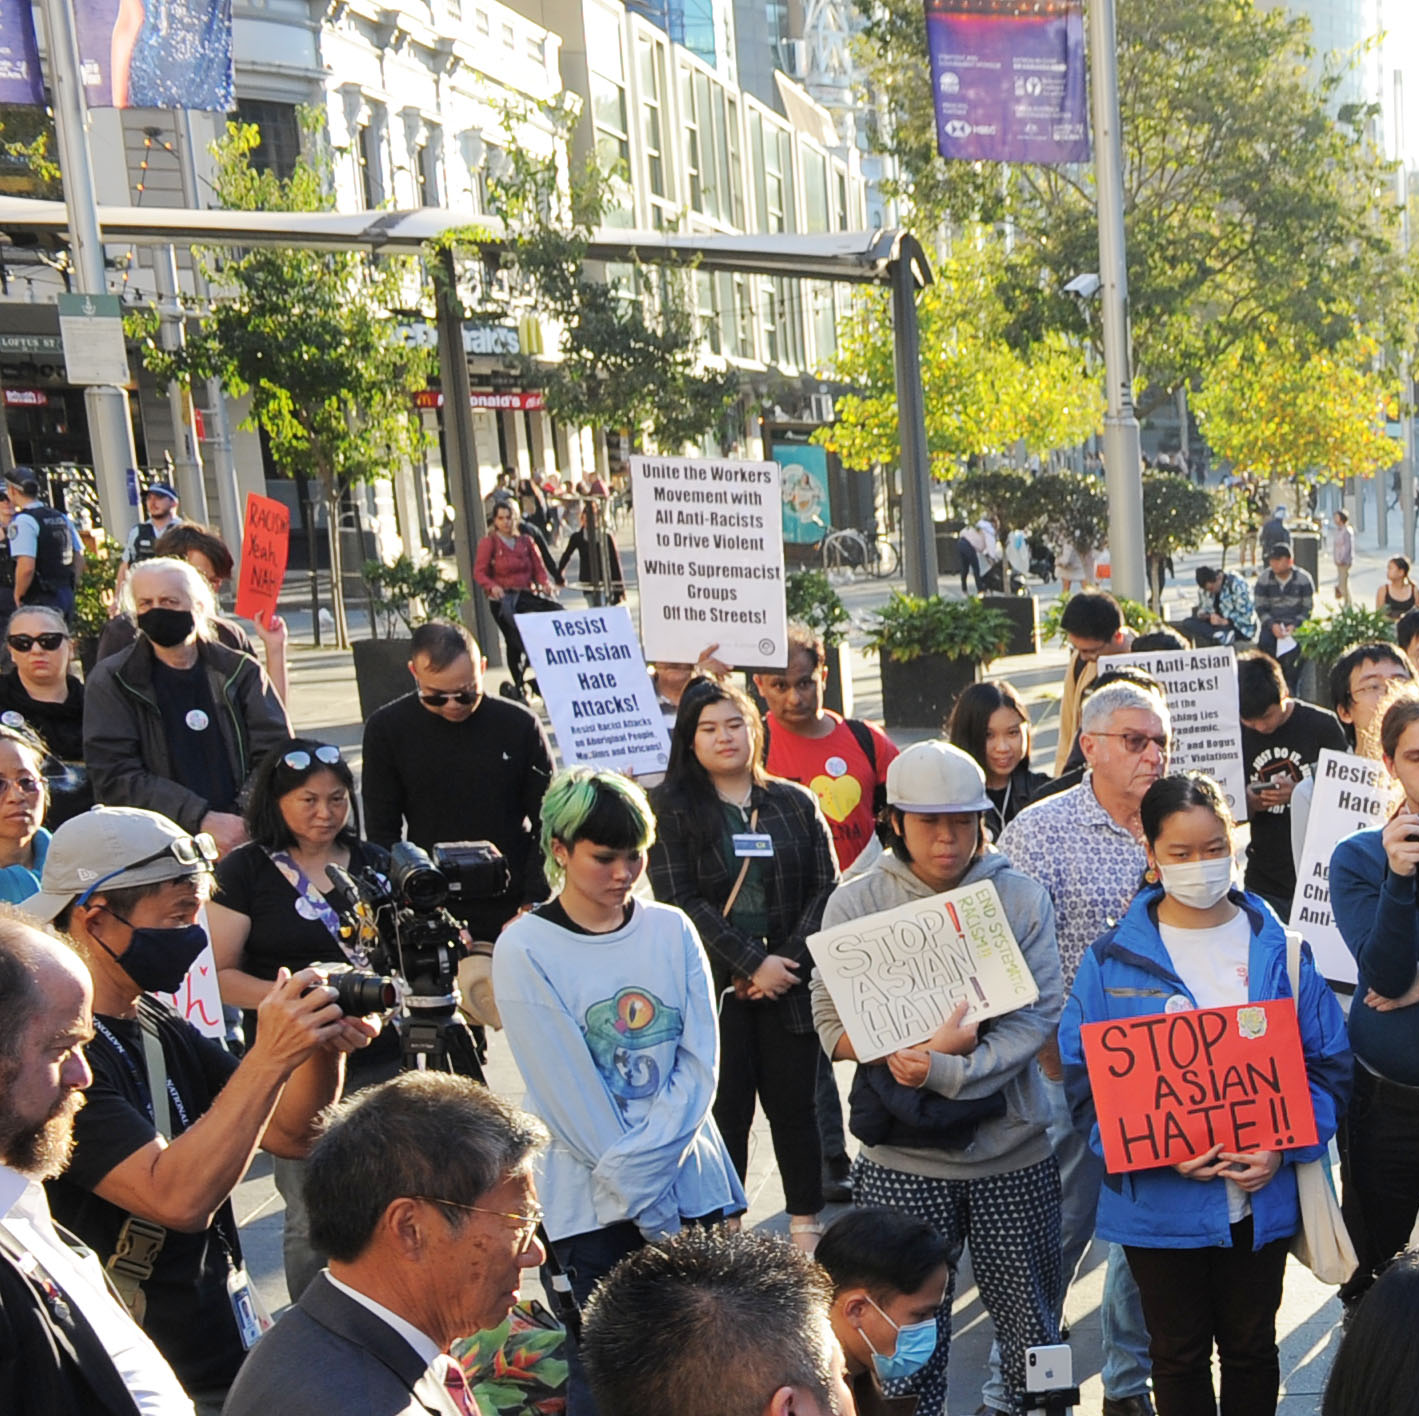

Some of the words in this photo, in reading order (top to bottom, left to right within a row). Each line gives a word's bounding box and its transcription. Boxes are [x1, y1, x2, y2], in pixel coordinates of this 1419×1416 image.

[1, 337, 40, 348] LOFTUS
[43, 338, 56, 348] ST
[642, 463, 680, 480] Unite
[684, 465, 707, 481] the
[710, 466, 772, 484] Workers
[654, 486, 728, 504] Movement
[730, 489, 763, 506] with
[655, 509, 674, 525] All
[676, 510, 764, 529] Anti-Racists
[656, 532, 671, 547] to
[673, 532, 710, 549] Drive
[713, 533, 765, 551] Violent
[644, 560, 685, 577] White
[688, 560, 781, 580] Supremacist
[687, 583, 738, 602] Groups
[663, 605, 681, 621] Off
[684, 605, 707, 622] the
[710, 606, 767, 625] Streets!
[552, 616, 608, 637] Resist
[545, 643, 632, 666] Anti-Asian
[1156, 655, 1230, 673] Anti-Asian
[577, 672, 617, 691] Hate
[572, 694, 640, 718] Attacks!
[1200, 710, 1219, 721] Lies
[570, 721, 596, 735] Resist
[597, 720, 621, 732] Racist
[623, 717, 652, 729] Attacks
[575, 739, 585, 748] on
[586, 734, 627, 747] Aboriginal
[1187, 740, 1204, 750] and
[1206, 738, 1236, 750] Bogus
[1192, 752, 1239, 765] Violations
[1338, 790, 1381, 816] Hate
[1303, 883, 1330, 902] Chi
[976, 888, 996, 919] END
[1299, 906, 1336, 928] Anti-
[988, 921, 1027, 995] SYSTEMATIC
[852, 937, 977, 1014] ASIAN
[1101, 1011, 1227, 1078] STOP
[1155, 1056, 1281, 1110] ASIAN
[166, 1079, 189, 1126] NATIONAL
